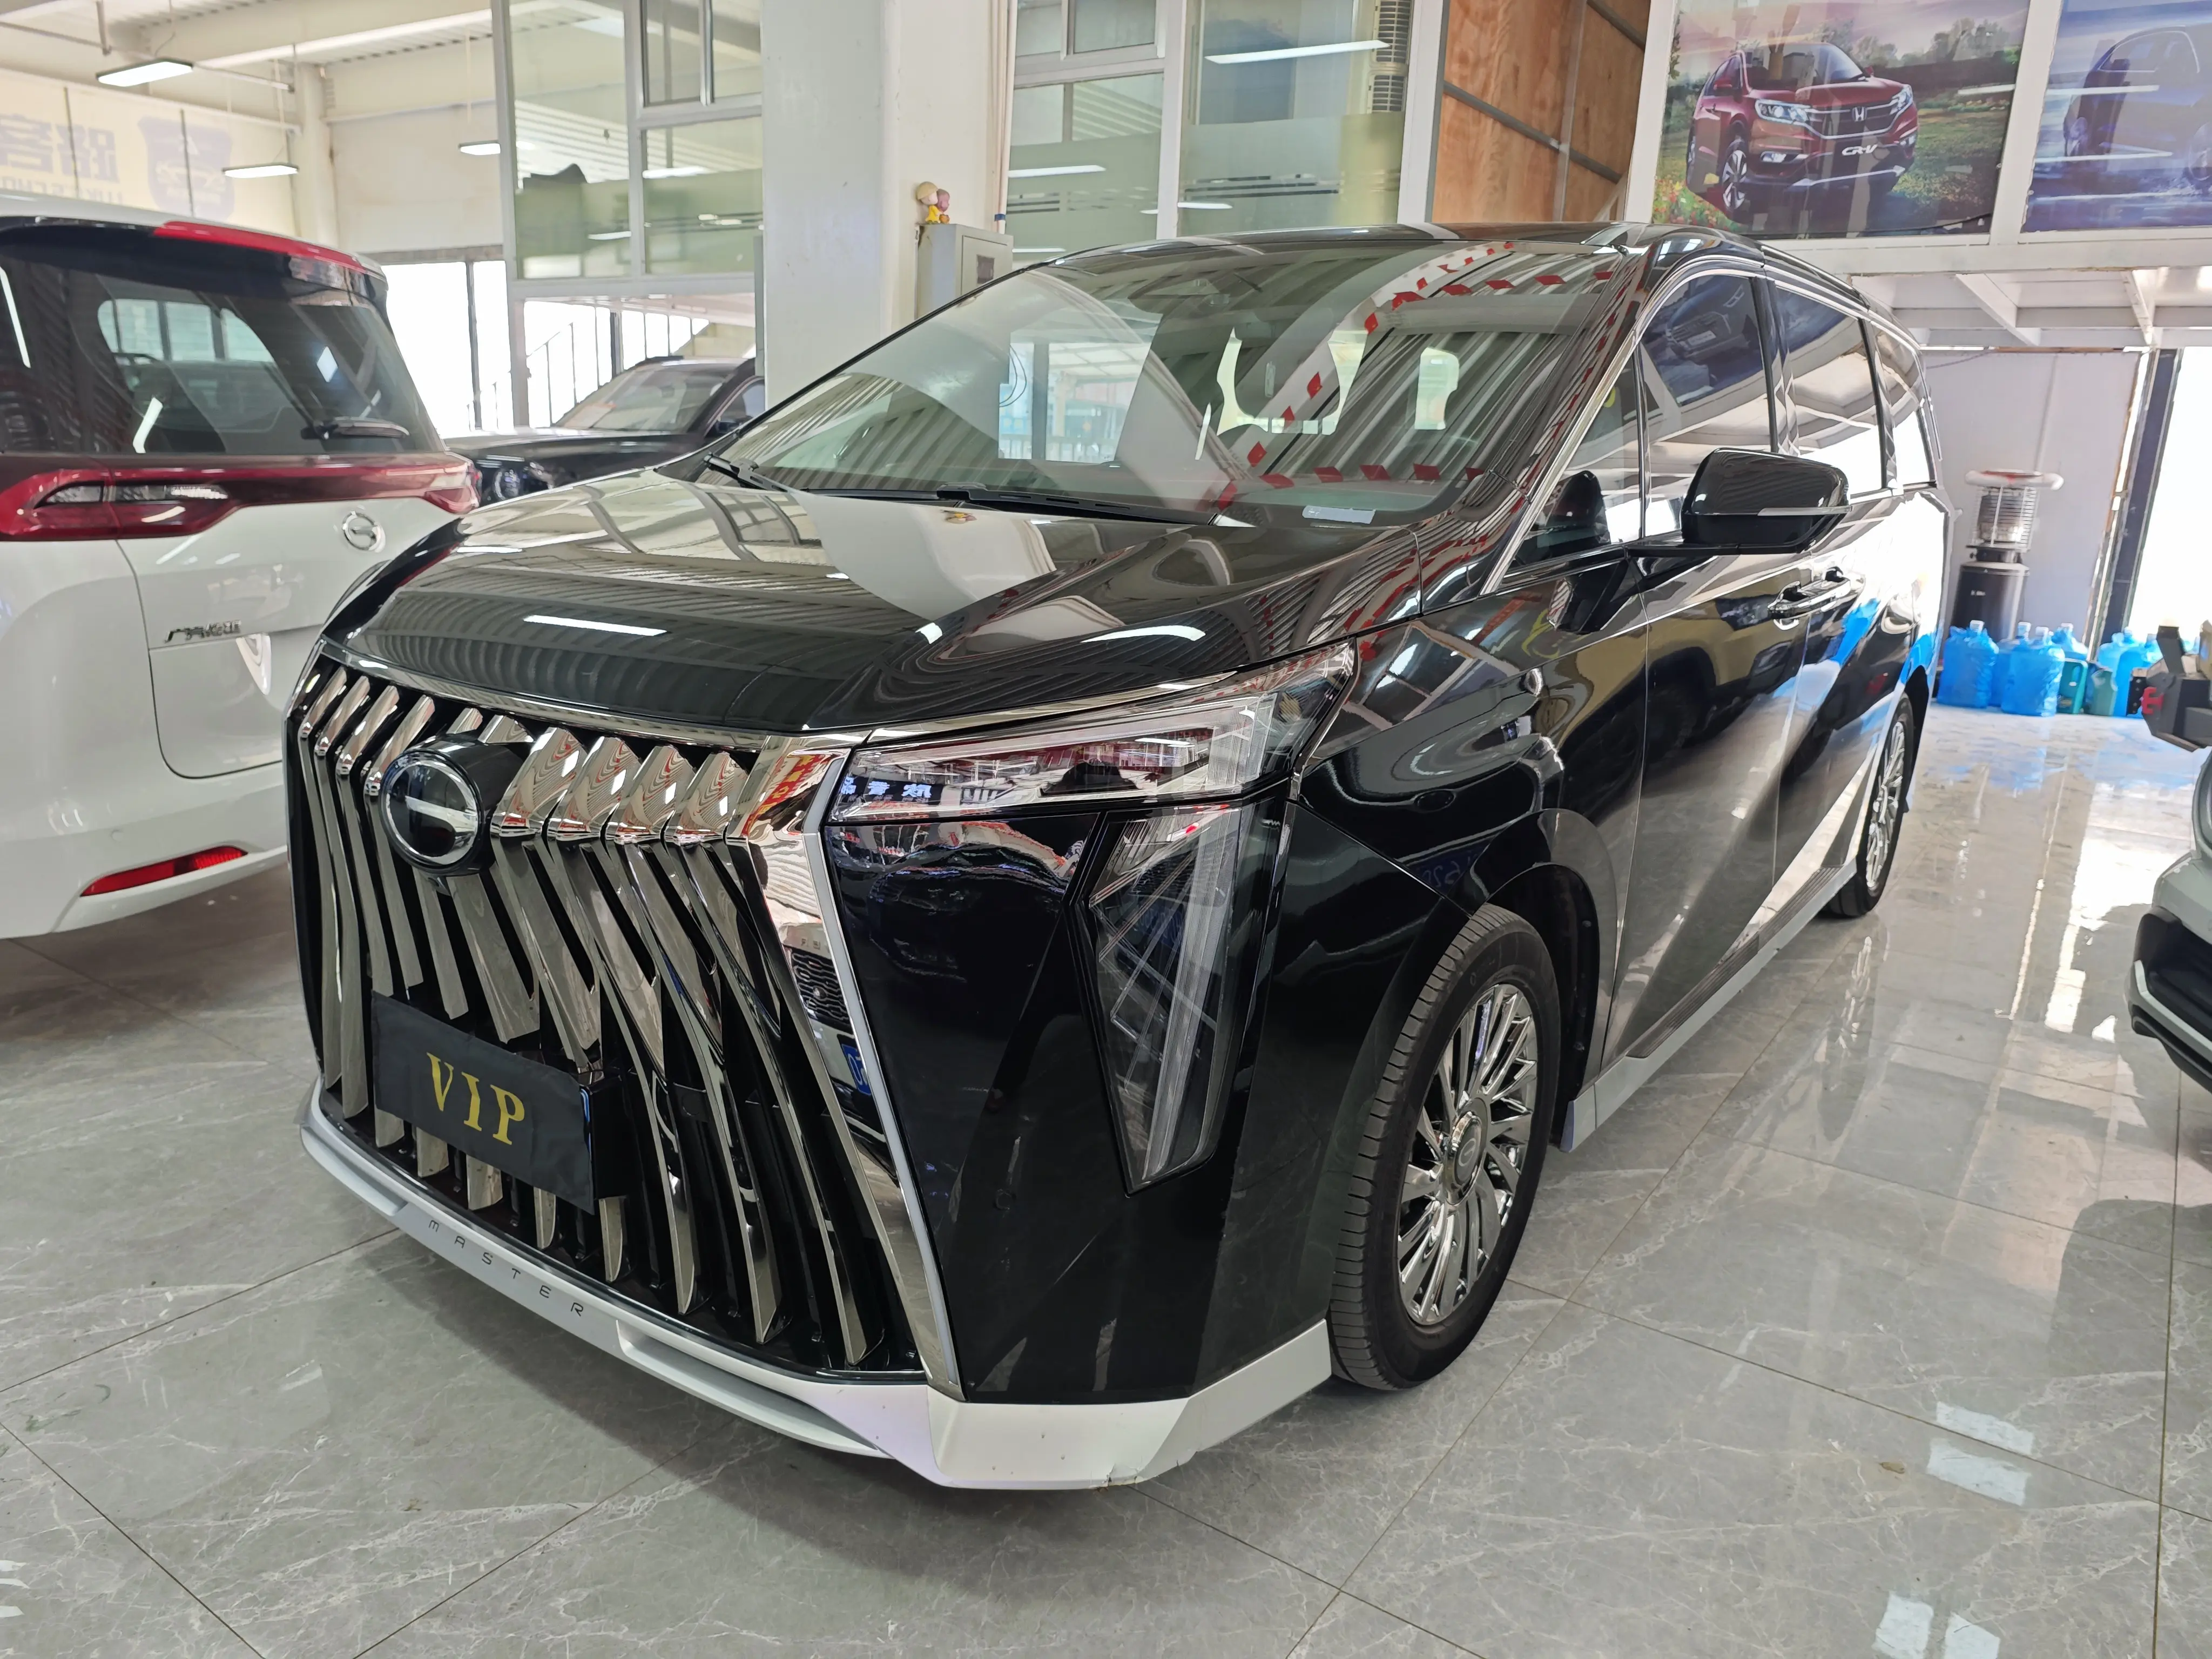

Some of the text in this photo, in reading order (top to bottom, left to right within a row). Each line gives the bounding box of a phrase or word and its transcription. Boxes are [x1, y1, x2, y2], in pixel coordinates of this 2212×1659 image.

[1842, 144, 1878, 156] CR-V
[426, 1051, 525, 1145] VIP
[428, 1219, 584, 1317] MASTER
